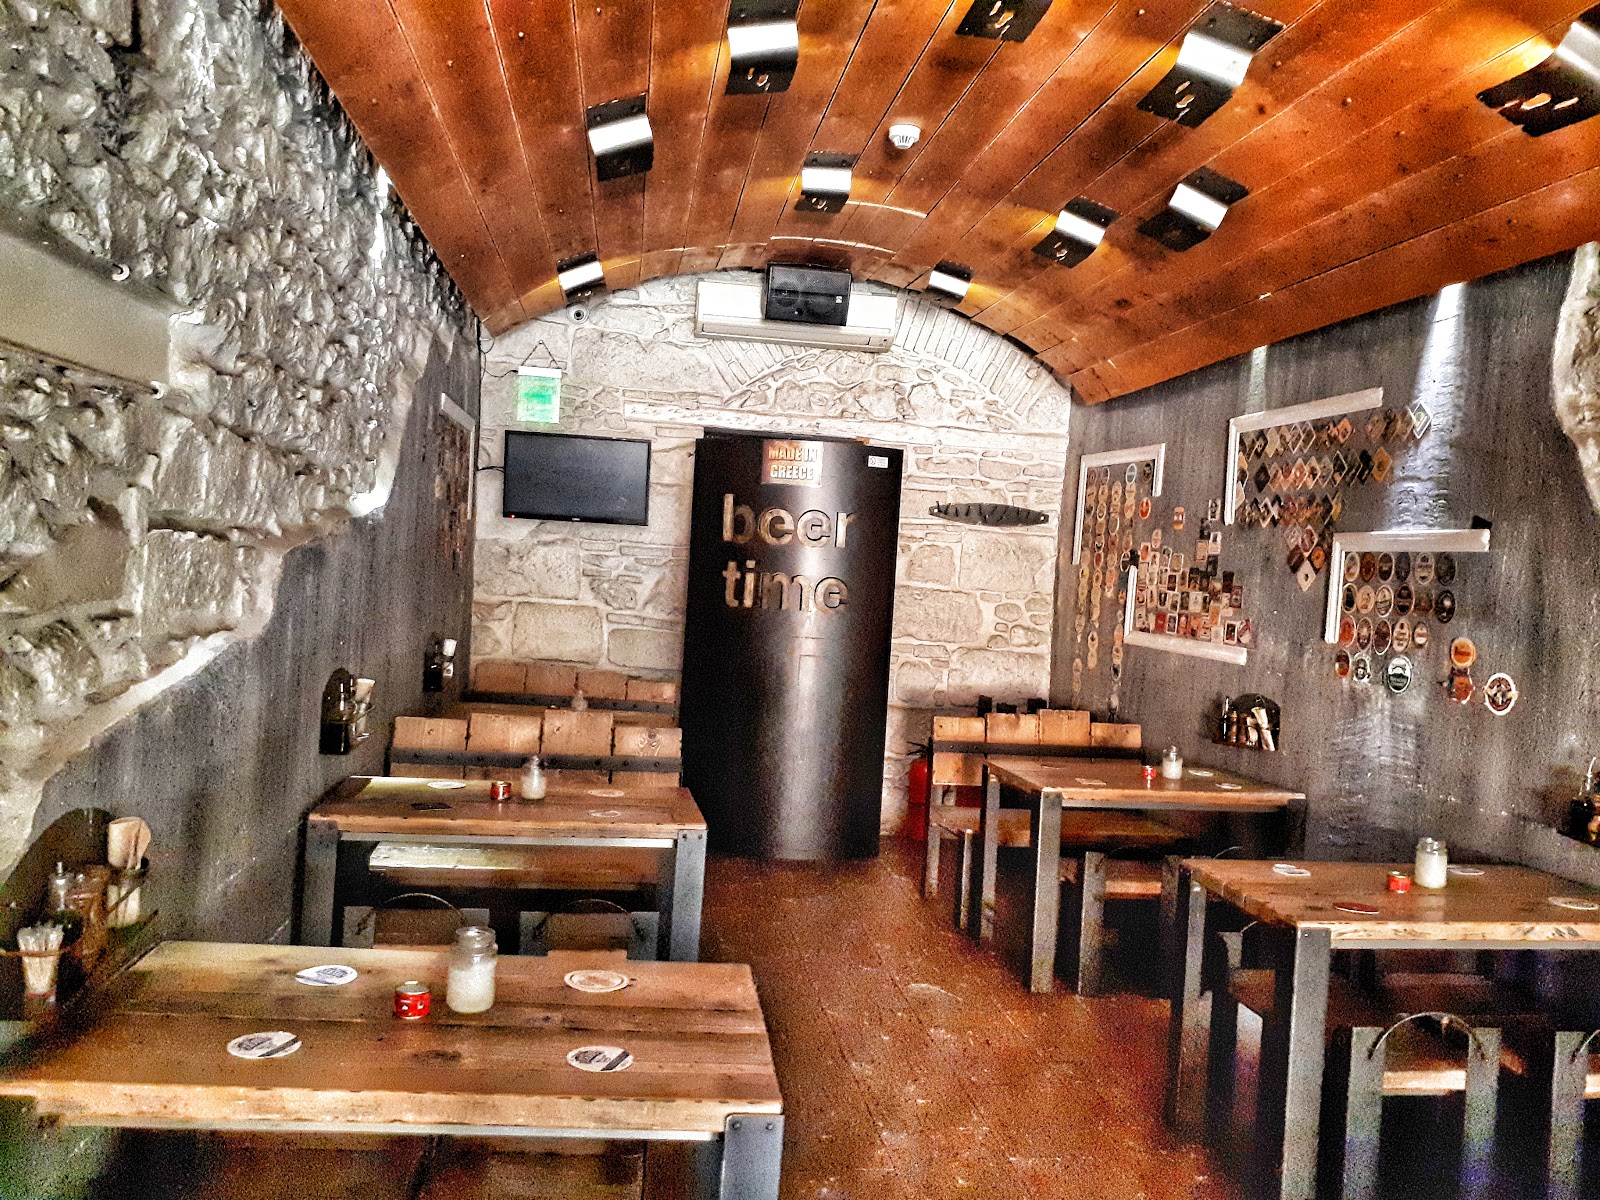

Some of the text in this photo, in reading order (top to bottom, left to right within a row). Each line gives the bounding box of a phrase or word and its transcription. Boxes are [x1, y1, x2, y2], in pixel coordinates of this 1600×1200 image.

[768, 446, 818, 462] MADE IN
[770, 464, 814, 480] GREECE
[722, 493, 855, 548] beer
[722, 560, 849, 615] time
